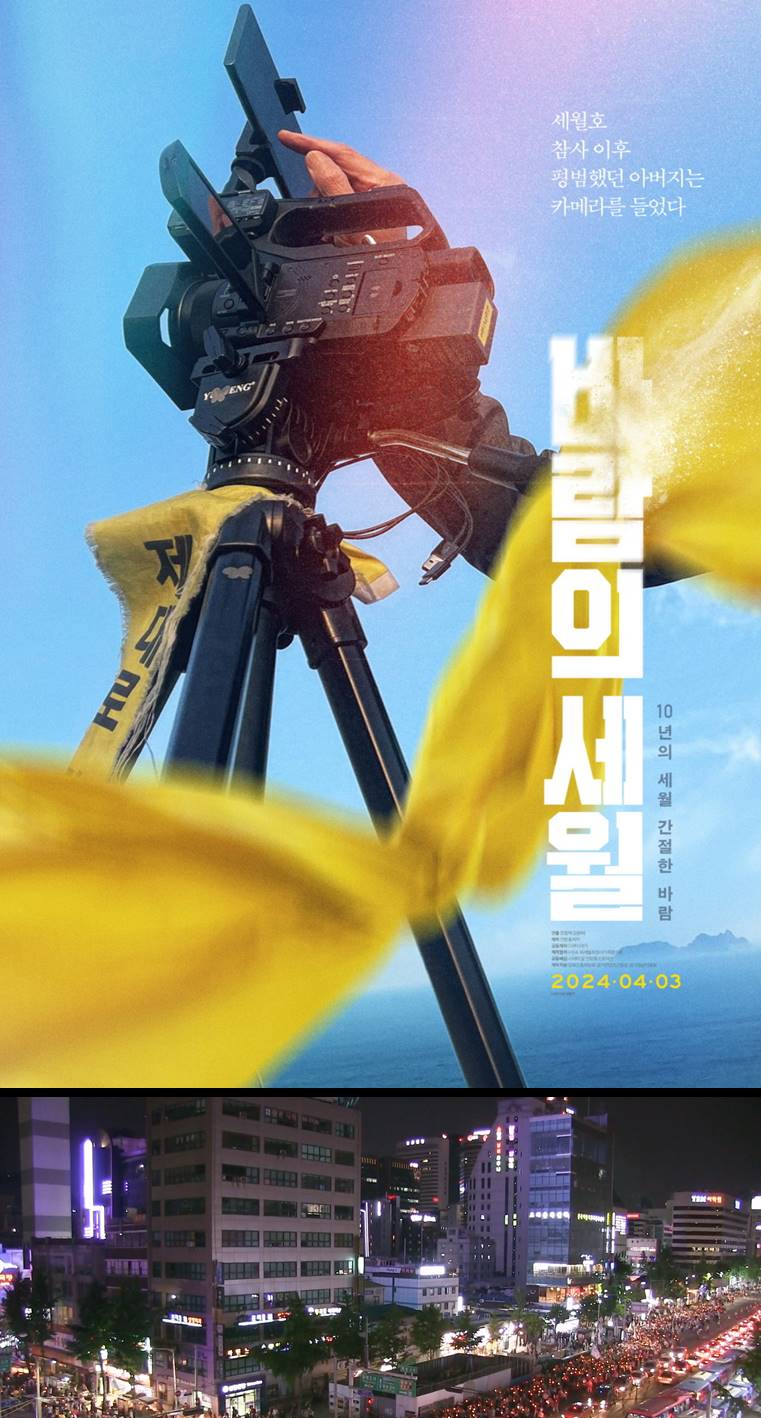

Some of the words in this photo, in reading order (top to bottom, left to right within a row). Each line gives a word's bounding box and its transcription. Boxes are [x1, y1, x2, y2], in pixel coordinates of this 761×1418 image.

[552, 111, 608, 131] 세월호
[552, 140, 589, 160] 참사
[593, 140, 631, 160] 이후
[552, 168, 625, 188] 평범했던
[629, 168, 705, 188] 아버지는
[551, 197, 626, 217] 카메라를
[630, 197, 687, 217] 들었다
[203, 383, 254, 402] YENG
[549, 335, 652, 679] 바람의
[656, 703, 673, 761] 10년의
[657, 772, 673, 808] 세월
[544, 696, 643, 921] 세월
[657, 819, 674, 874] 간절한
[657, 886, 674, 922] 바람
